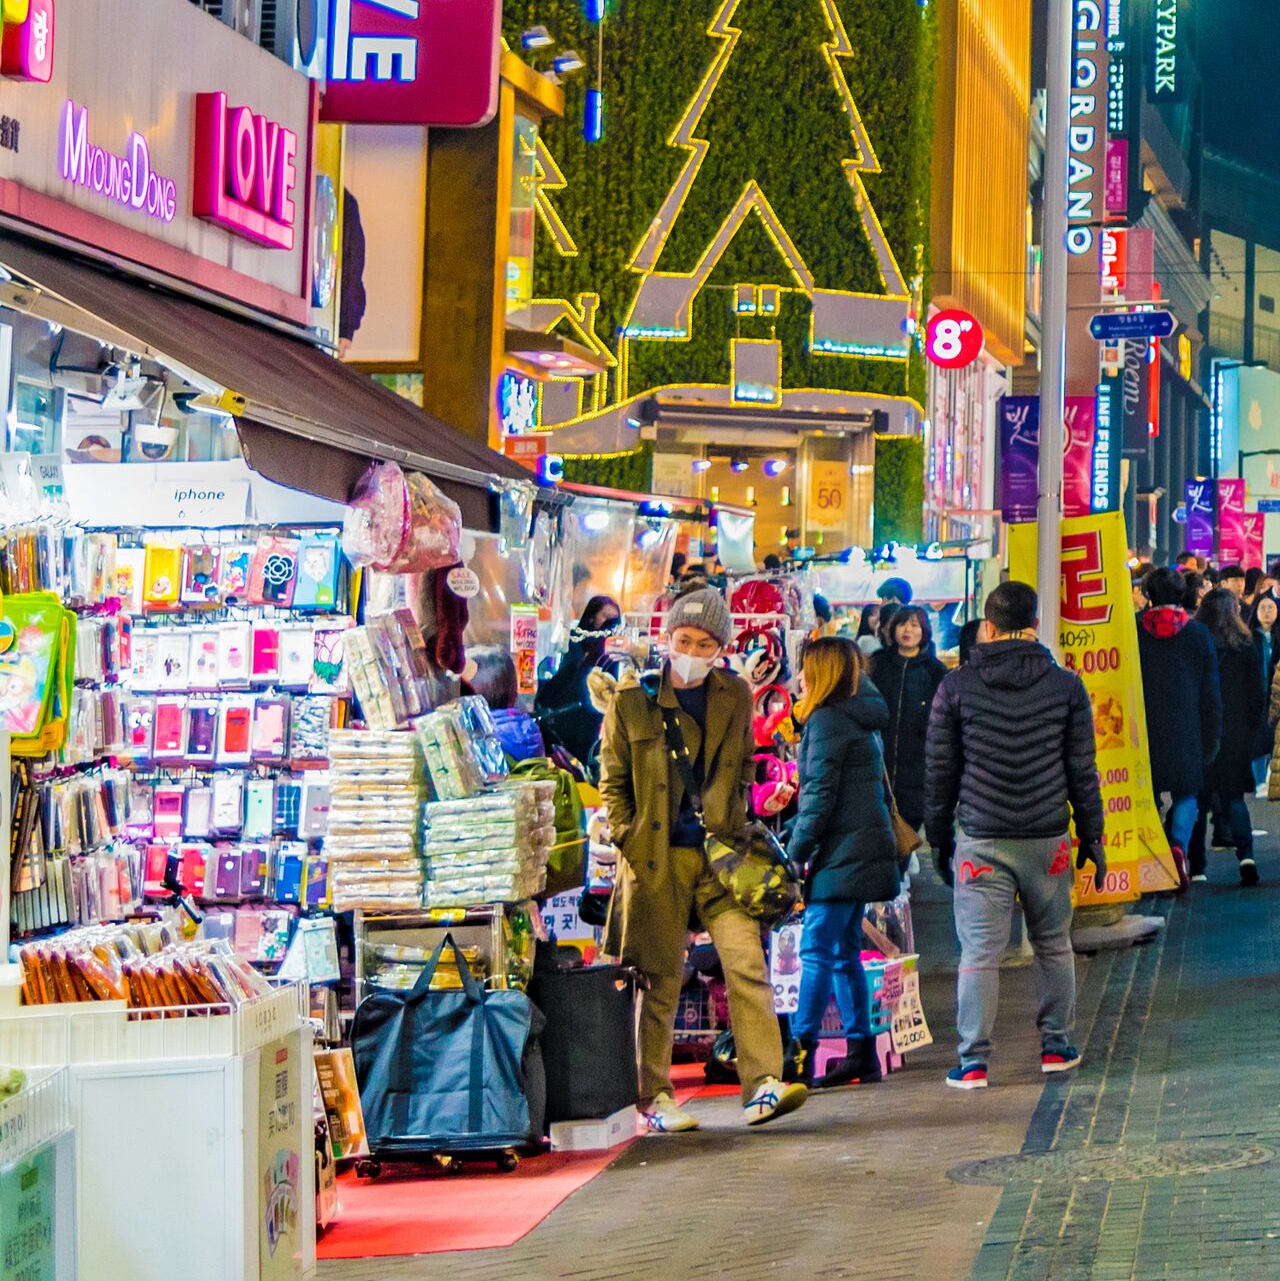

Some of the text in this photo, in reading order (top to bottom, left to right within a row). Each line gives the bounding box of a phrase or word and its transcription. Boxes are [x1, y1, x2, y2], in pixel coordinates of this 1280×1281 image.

[206, 90, 298, 250] LOVE
[173, 488, 226, 503] iphone
[1093, 430, 1110, 510] FRIENDS
